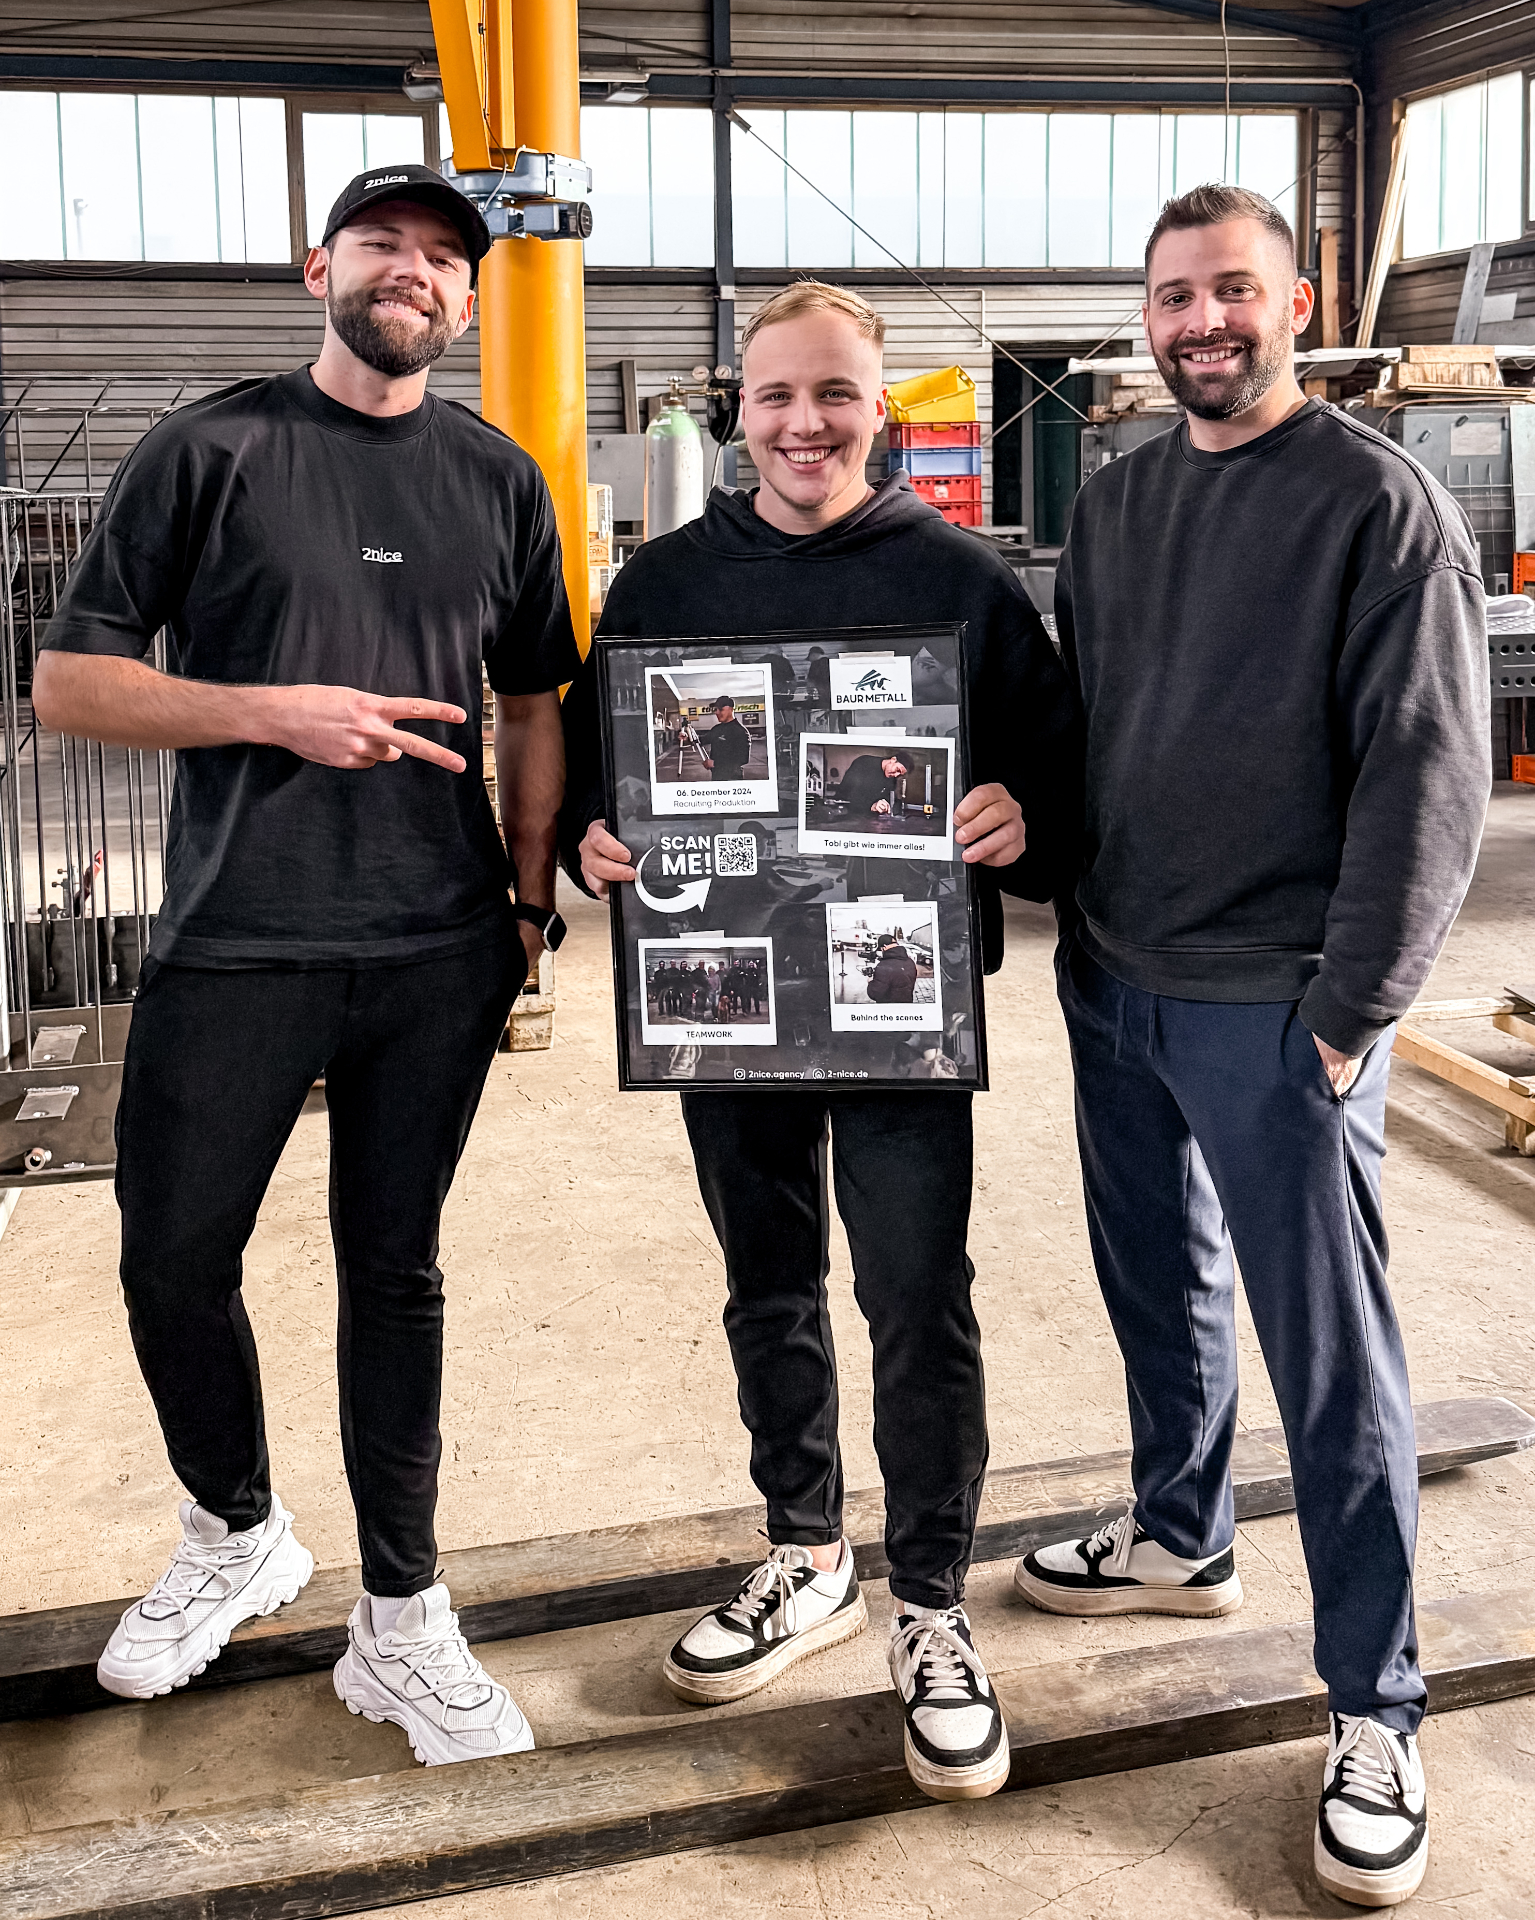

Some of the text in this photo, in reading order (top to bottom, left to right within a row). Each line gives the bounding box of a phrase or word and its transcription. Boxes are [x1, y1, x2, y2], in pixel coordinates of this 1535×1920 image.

[363, 175, 409, 190] 2nice
[361, 546, 404, 563] 2nice
[836, 693, 907, 704] BAUR METALL
[676, 787, 752, 797] 06. Dezember 2024
[673, 799, 756, 809] Recruiting Produktion
[661, 835, 711, 851] SCAN
[843, 840, 860, 849] gibt
[861, 841, 875, 849] wie
[877, 842, 902, 850] immer
[903, 843, 925, 851] alles!
[662, 852, 713, 876] ME!
[850, 1013, 924, 1022] Behind the scenes
[686, 1030, 733, 1039] TEAMWORK
[748, 1069, 869, 1080] 2nice.agency 2-nice.de
